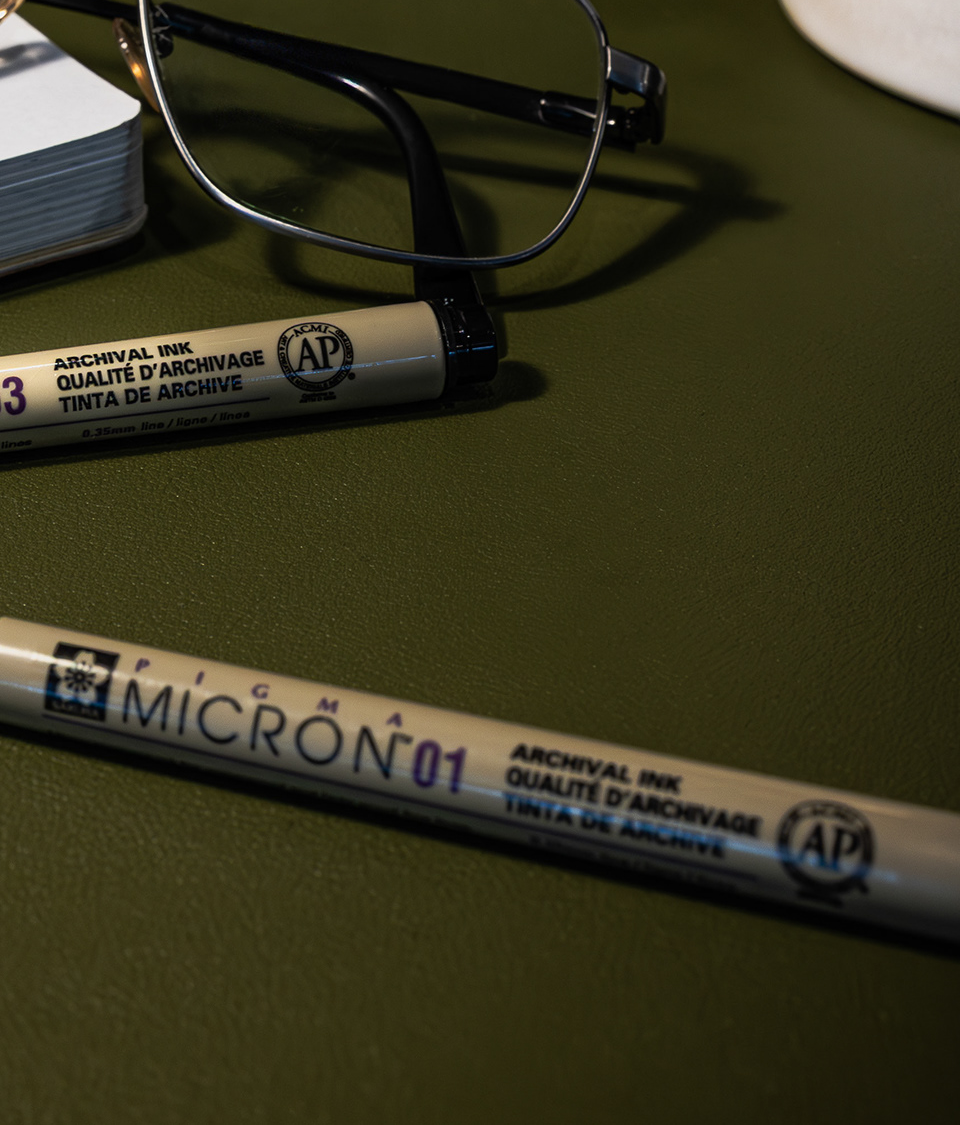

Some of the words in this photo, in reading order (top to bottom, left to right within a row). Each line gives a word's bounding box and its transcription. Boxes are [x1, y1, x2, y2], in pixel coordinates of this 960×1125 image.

[293, 324, 329, 337] ACMI
[54, 347, 154, 371] ARCHIVAL
[157, 341, 194, 357] INK
[56, 363, 136, 391] QUALITÉ
[139, 349, 265, 381] D'ARCHIVAGE
[294, 335, 340, 372] AP
[59, 391, 119, 413] TINTA
[124, 386, 152, 405] DE
[157, 374, 243, 401] ARCHIVE
[1, 439, 32, 450] lines
[141, 420, 165, 431] line
[135, 658, 404, 727] PIGMA
[122, 679, 401, 780] MICRON
[411, 739, 468, 794] 01
[510, 743, 631, 784] ARCHIVAL
[638, 768, 683, 794] INK
[507, 765, 601, 803] QUALITÉ
[605, 788, 762, 837] D'ARCHIVAGE
[504, 793, 572, 825] TINTA
[581, 810, 610, 833] DE
[620, 816, 727, 859] ARCHIVE
[800, 822, 860, 870] AP
